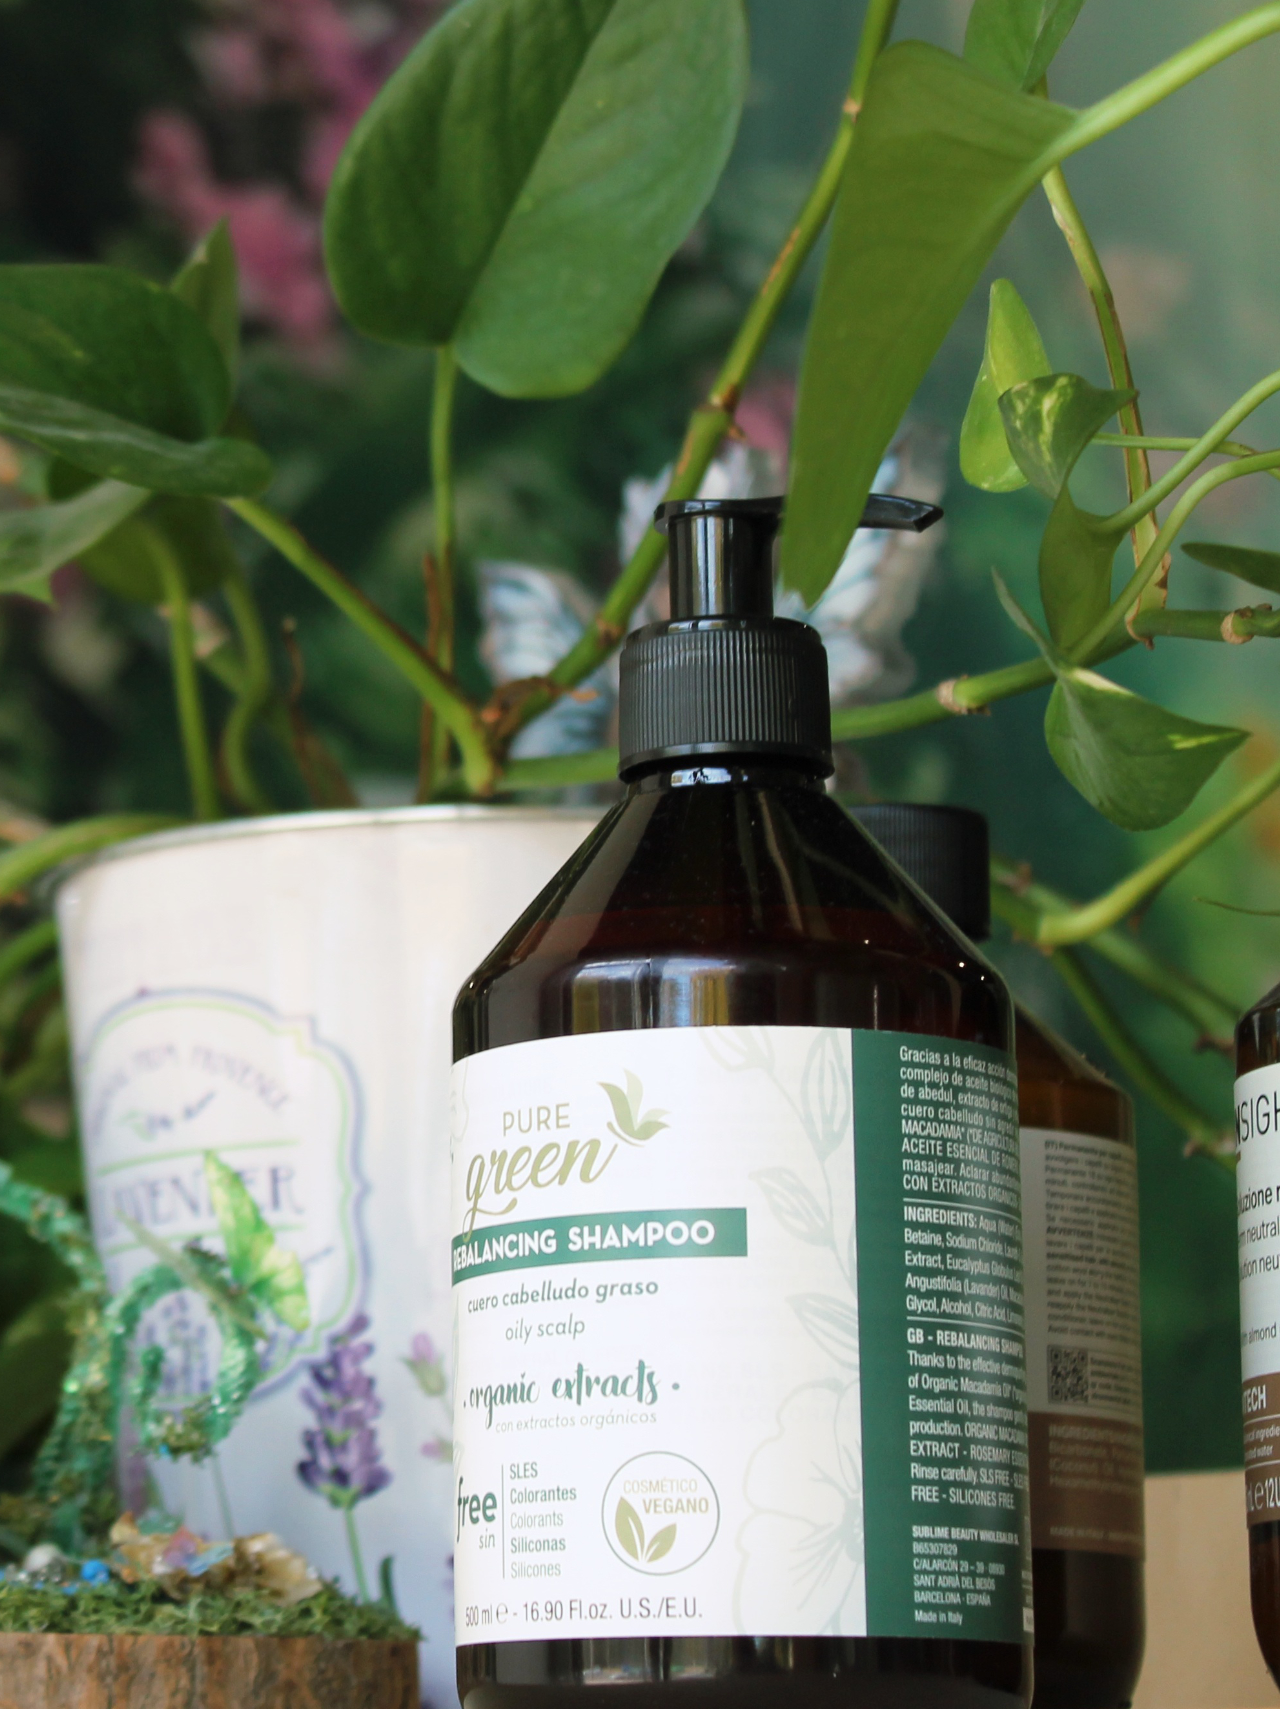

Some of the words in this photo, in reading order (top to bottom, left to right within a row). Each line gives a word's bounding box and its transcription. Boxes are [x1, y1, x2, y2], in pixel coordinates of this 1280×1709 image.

[899, 1045, 941, 1065] Gracias
[943, 1053, 950, 1067] a
[952, 1052, 961, 1069] la
[963, 1054, 986, 1073] eficaz
[899, 1066, 949, 1086] complejo
[951, 1070, 963, 1086] de
[965, 1075, 989, 1091] aceite
[900, 1082, 915, 1099] de
[918, 1085, 956, 1105] abedul,
[958, 1091, 990, 1110] extracto
[502, 1102, 571, 1137] PURE
[900, 1103, 935, 1119] cuero
[938, 1106, 984, 1127] cabelludo
[901, 1137, 943, 1157] ACEITE
[946, 1141, 990, 1164] ESENCIAL
[991, 1150, 1001, 1167] DE
[902, 1158, 957, 1177] masajear.
[959, 1162, 990, 1181] Aclarar
[462, 1137, 618, 1244] green
[902, 1173, 928, 1192] CON
[931, 1176, 987, 1200] EXTRACTOS
[903, 1205, 977, 1229] INGREDIENTS:
[979, 1214, 997, 1233] Aqua
[452, 1228, 557, 1273] REBALANCING
[567, 1219, 715, 1253] SHAMPOO
[904, 1227, 945, 1248] Betaine,
[946, 1231, 977, 1250] Sodium
[904, 1249, 945, 1270] Extract,
[946, 1253, 991, 1276] Eucalyptus
[905, 1272, 962, 1293] Angustifolia
[467, 1293, 499, 1314] cuero
[502, 1278, 589, 1306] cabelludo
[596, 1281, 659, 1304] graso
[906, 1293, 940, 1315] Glycol,
[940, 1296, 974, 1318] Alcohol,
[505, 1317, 533, 1344] oily
[537, 1312, 586, 1340] scalp
[906, 1326, 924, 1344] GB
[936, 1329, 1000, 1353] REBALANCING
[906, 1349, 945, 1369] Thanks
[946, 1353, 956, 1370] to
[956, 1354, 971, 1371] the
[469, 1372, 540, 1431] organic
[551, 1359, 661, 1406] extracts
[907, 1372, 919, 1389] of
[921, 1372, 959, 1393] Organic
[960, 1376, 1002, 1397] Macadamia
[908, 1394, 955, 1414] Essential
[956, 1398, 971, 1417] Oil,
[971, 1400, 985, 1416] the
[495, 1421, 514, 1434] con
[516, 1413, 576, 1431] extractos
[580, 1408, 657, 1428] orgánicos
[909, 1418, 963, 1437] production.
[964, 1421, 998, 1440] ORGANIC
[909, 1439, 960, 1459] EXTRACT
[969, 1443, 1011, 1465] ROSEMARY
[509, 1461, 538, 1480] SLES
[910, 1462, 939, 1480] Rinse
[979, 1467, 995, 1485] SLS
[994, 1469, 1010, 1488] FREE
[510, 1485, 578, 1504] Colorantes
[623, 1478, 698, 1494] COSMÉTICO
[911, 1484, 939, 1503] FREE
[948, 1487, 997, 1508] SILICONES
[642, 1497, 709, 1515] VEGANO
[510, 1511, 564, 1530] Colorants
[911, 1524, 950, 1539] SUBLIME
[950, 1526, 979, 1541] BEAUTY
[478, 1527, 496, 1550] sin
[510, 1535, 566, 1554] Siliconas
[510, 1560, 562, 1579] Silicones
[913, 1573, 935, 1588] SANT
[961, 1575, 975, 1590] DEL
[914, 1591, 962, 1605] BARCELONA
[465, 1604, 479, 1628] 500
[481, 1603, 493, 1626] ml
[523, 1600, 564, 1622] 16.90
[619, 1596, 703, 1619] U.S./E.U.
[914, 1608, 938, 1623] Made
[938, 1610, 947, 1623] in
[947, 1610, 963, 1626] Italy
